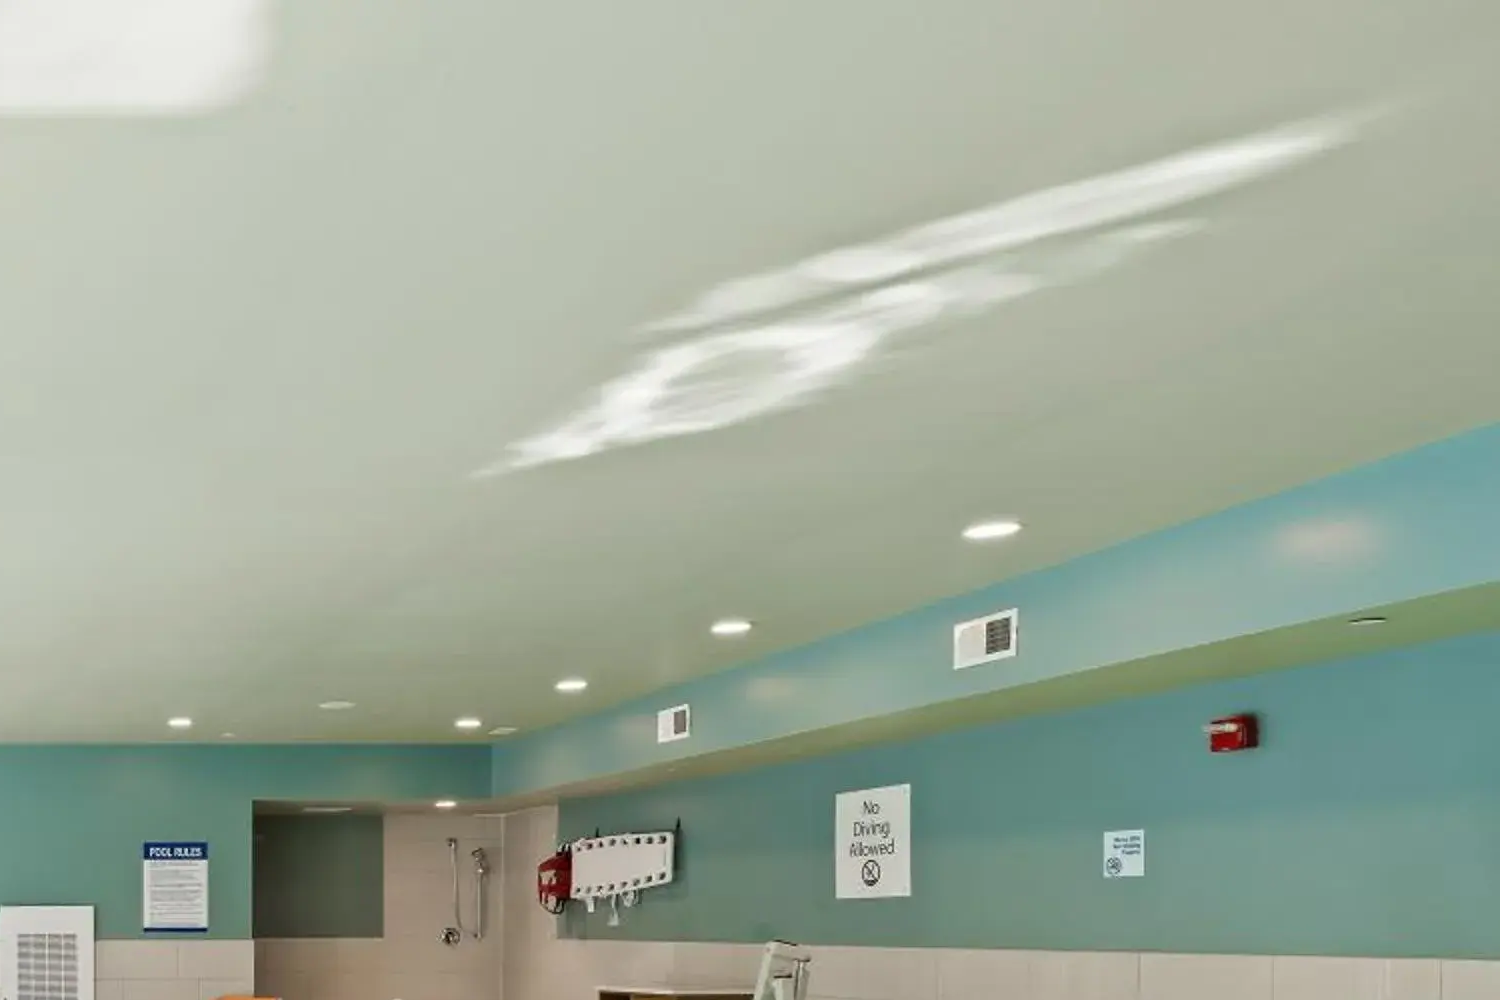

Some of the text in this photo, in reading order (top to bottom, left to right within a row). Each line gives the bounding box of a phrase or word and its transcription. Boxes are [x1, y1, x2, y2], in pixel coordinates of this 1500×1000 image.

[863, 800, 880, 815] No
[853, 820, 891, 839] Diving
[149, 847, 203, 857] POOL RULES
[850, 838, 896, 857] Allowed
